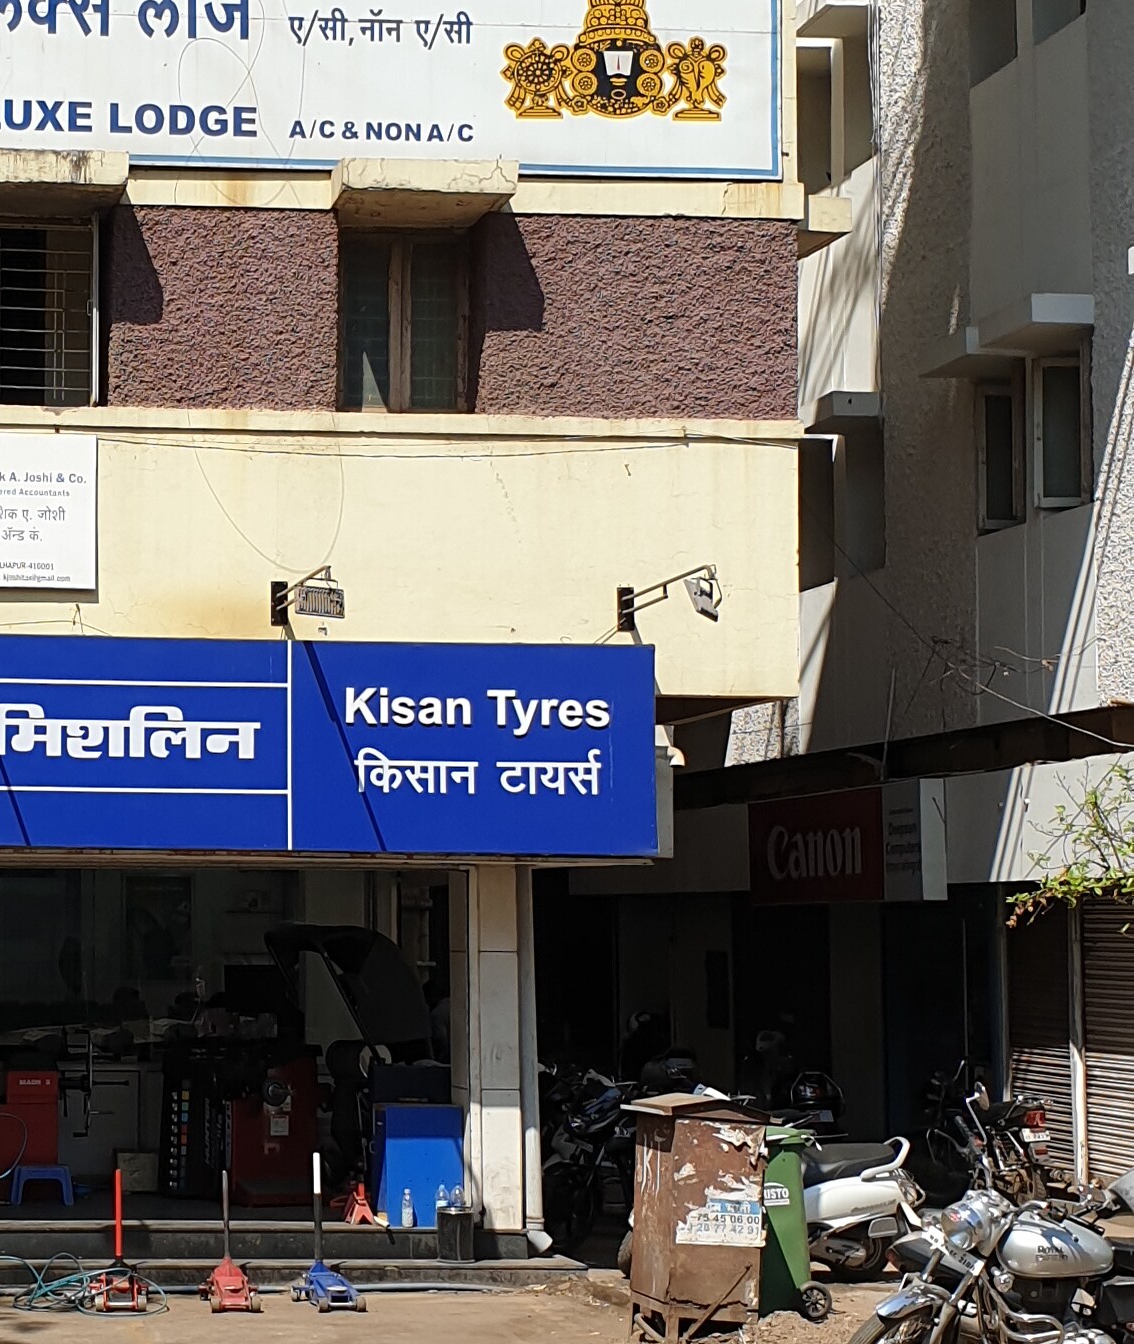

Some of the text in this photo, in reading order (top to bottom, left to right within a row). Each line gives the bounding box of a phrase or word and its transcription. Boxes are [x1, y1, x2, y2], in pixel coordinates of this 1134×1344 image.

[109, 101, 259, 138] LODGE
[288, 119, 474, 143] A/C & NON A/C
[9, 472, 21, 482] A.
[24, 472, 52, 483] Joshi
[56, 472, 65, 483] &
[68, 473, 87, 484] Co.
[18, 488, 70, 497] Accountants
[36, 505, 66, 521] जोशी
[344, 687, 611, 738] Kisan Tyres
[354, 747, 603, 797] किसान टायर्स
[767, 824, 863, 881] Canon
